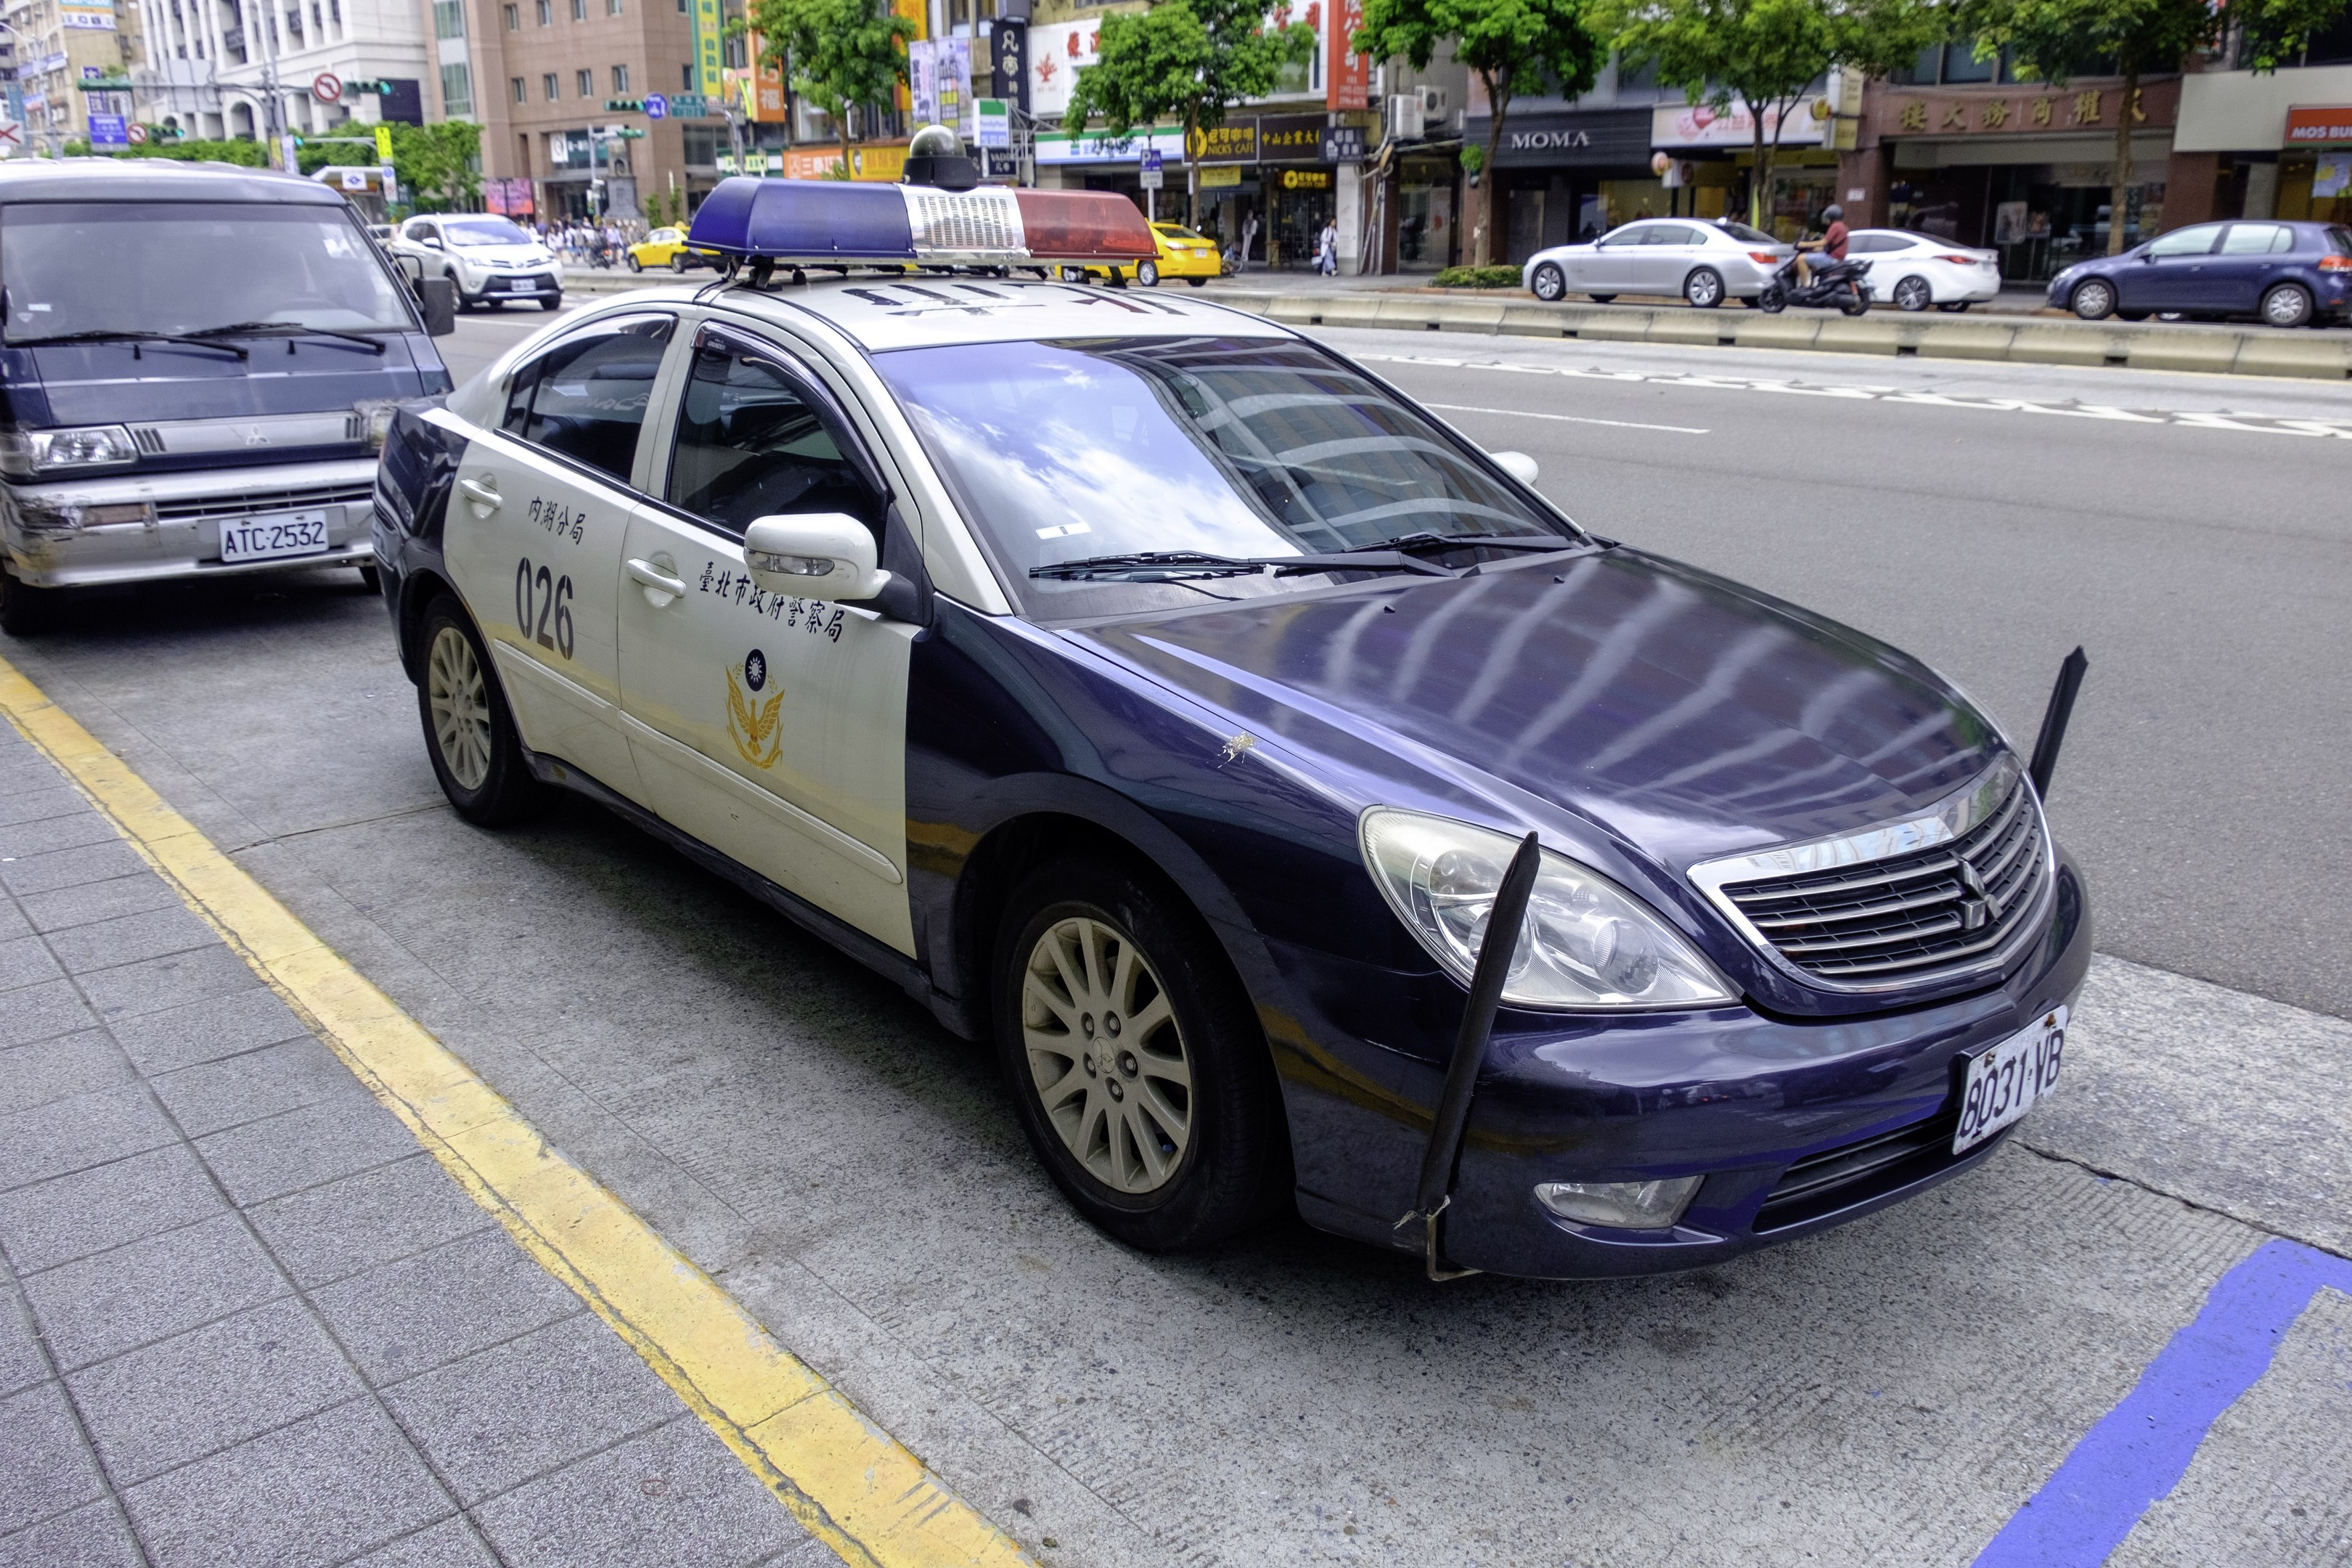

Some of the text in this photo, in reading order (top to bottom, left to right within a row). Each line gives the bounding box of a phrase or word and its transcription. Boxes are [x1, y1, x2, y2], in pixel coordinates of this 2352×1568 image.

[1261, 129, 1320, 146] 中山企業大
[1511, 130, 1591, 150] MOMA
[2290, 125, 2327, 139] MOS
[1141, 150, 1152, 167] P
[515, 556, 574, 661] 026
